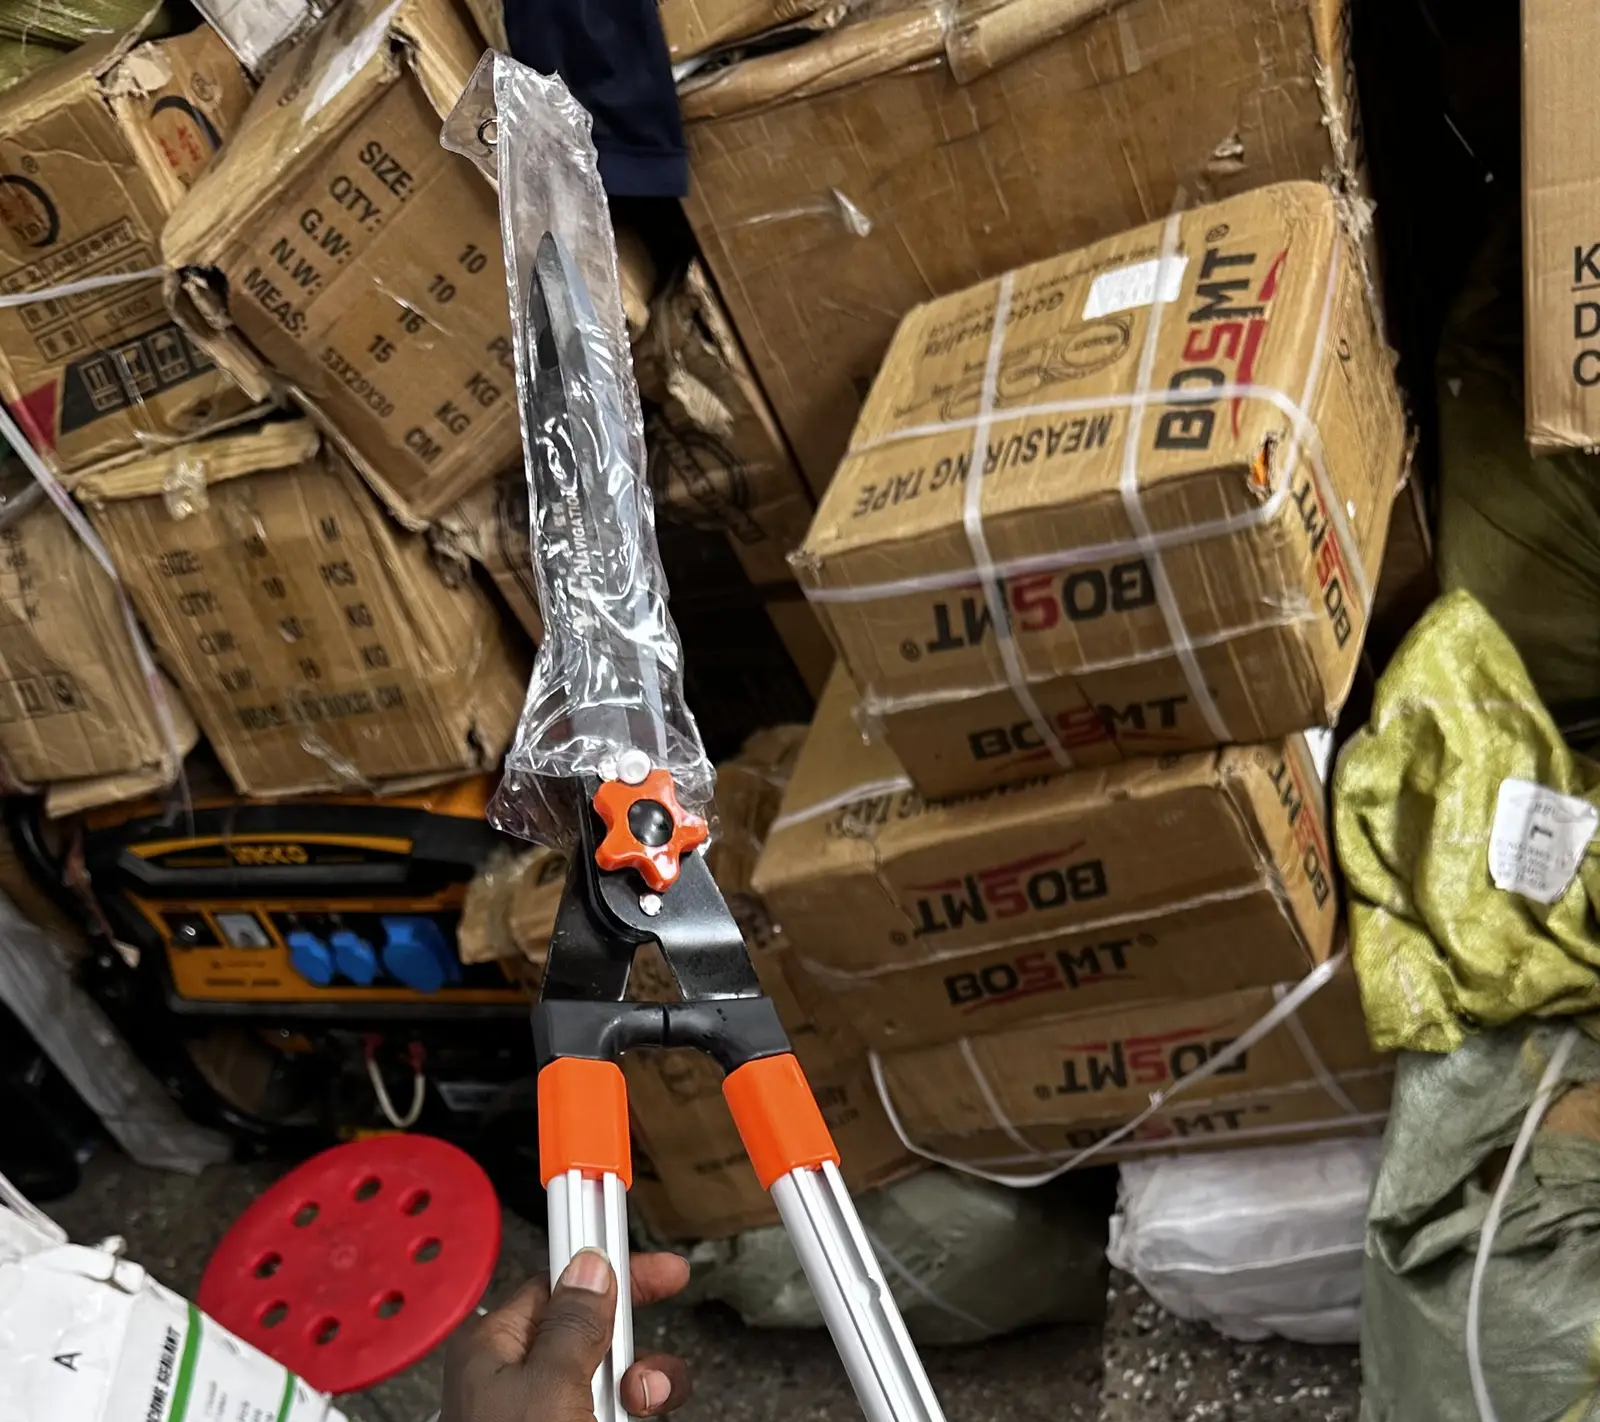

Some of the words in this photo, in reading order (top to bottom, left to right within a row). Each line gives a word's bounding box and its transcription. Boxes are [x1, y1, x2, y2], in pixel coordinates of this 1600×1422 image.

[328, 175, 382, 232] QTY:
[427, 274, 457, 304] 10
[358, 140, 415, 203] SIZE:
[458, 243, 488, 275] 10
[243, 266, 309, 339] MEAS:
[403, 426, 443, 463] CM
[269, 237, 323, 296] N.W:
[367, 334, 397, 364] 15
[434, 402, 471, 435] KG
[299, 207, 351, 264] G.W:
[464, 371, 501, 408] KG
[1155, 247, 1265, 450] BOSMT
[853, 467, 925, 518] TAPE
[1292, 483, 1351, 648] BOSMT
[912, 859, 1108, 938] BOSMT
[944, 940, 1133, 1006] BOSMT
[52, 1352, 82, 1372] A
